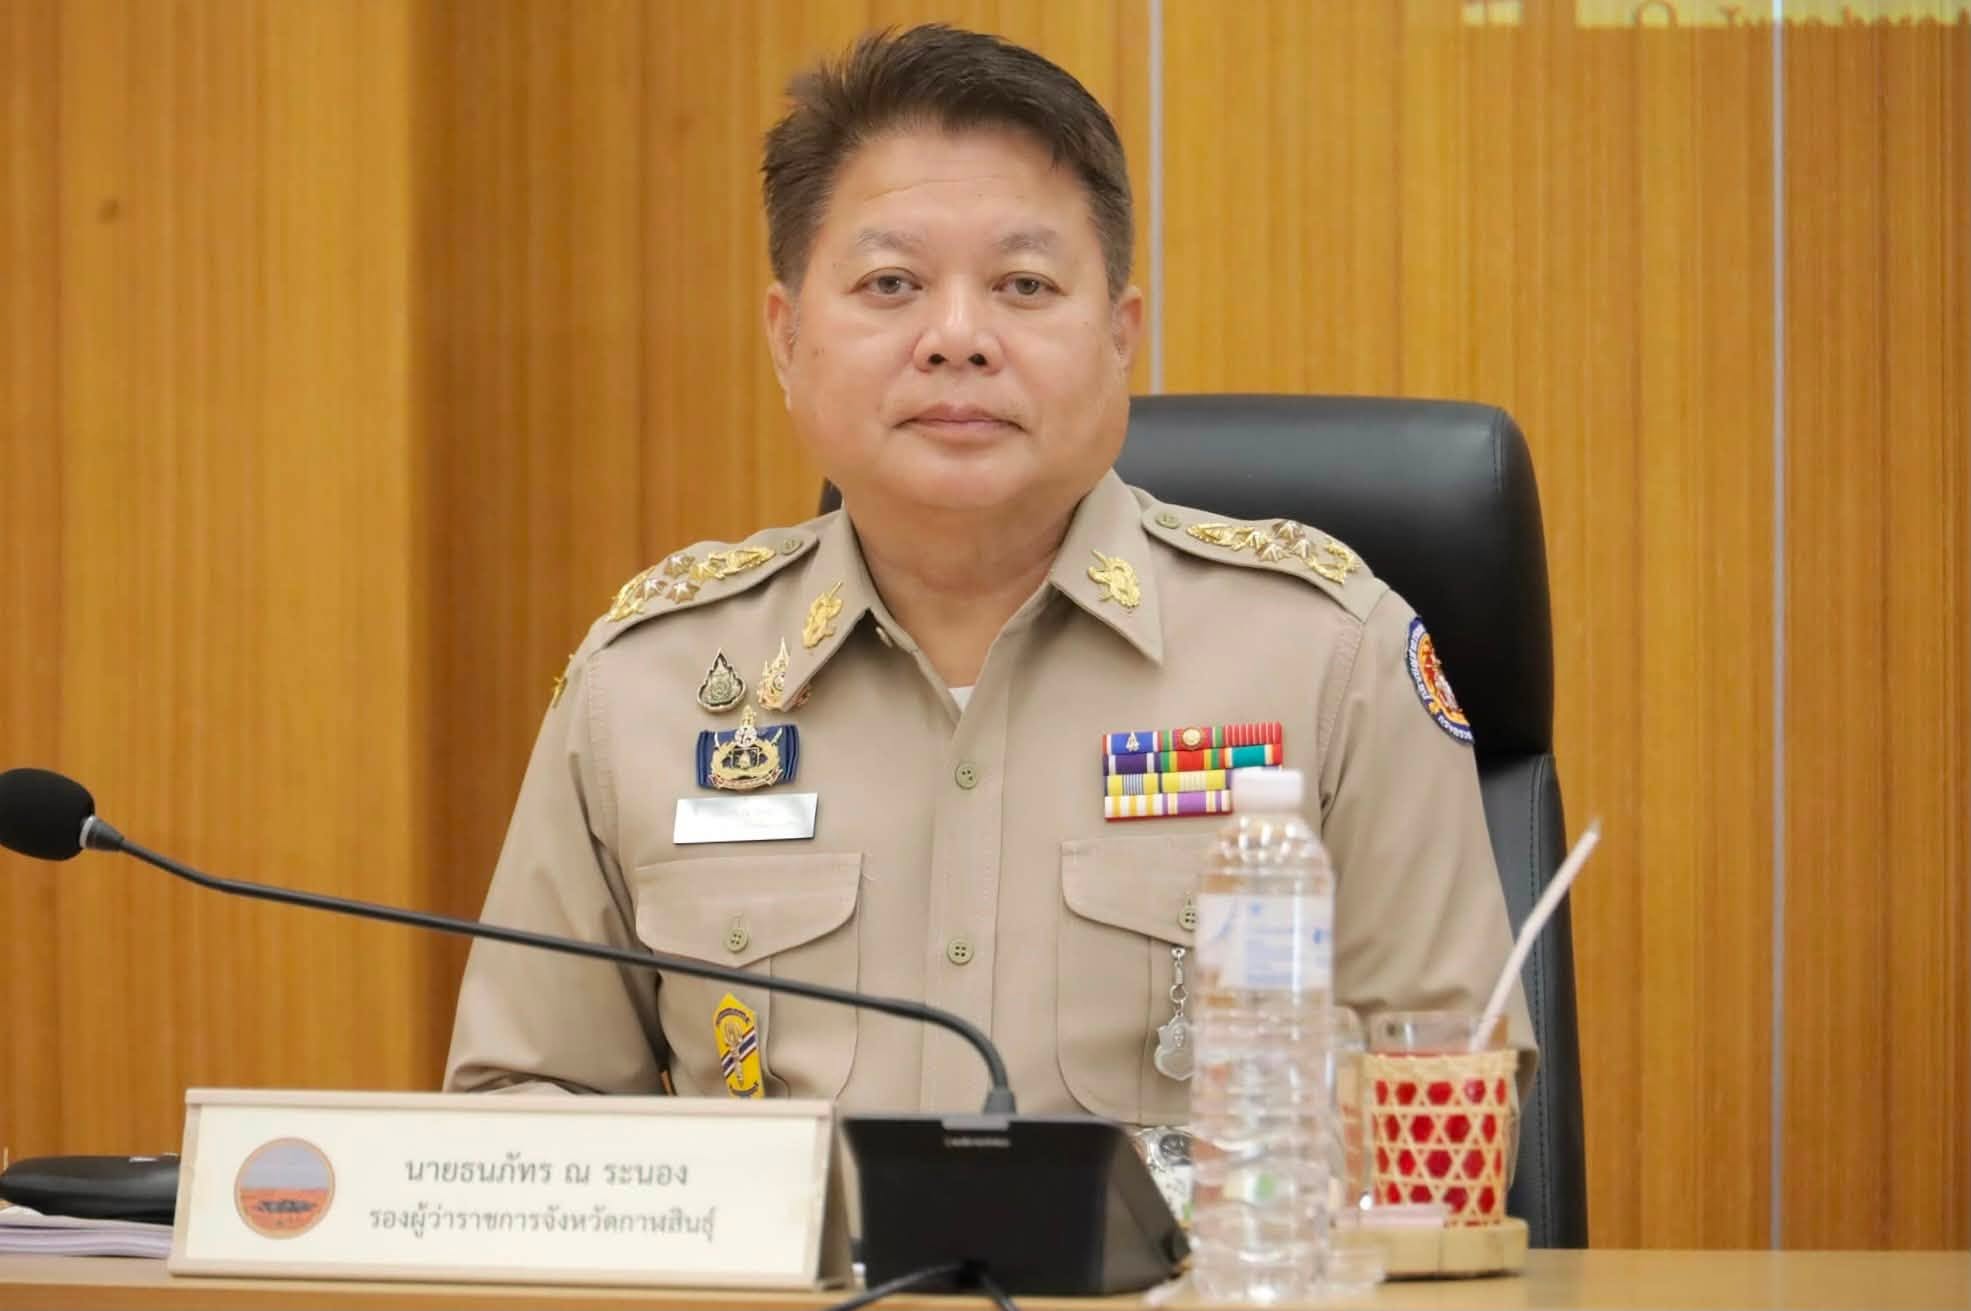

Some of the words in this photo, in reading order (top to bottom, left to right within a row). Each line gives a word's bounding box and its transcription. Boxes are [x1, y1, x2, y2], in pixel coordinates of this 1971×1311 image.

[405, 1151, 552, 1184] นายธนภัทร
[564, 1163, 591, 1184] ณ
[603, 1164, 688, 1186] ระนอง
[369, 1201, 716, 1243] รองผู้ว่าราชการจังหวัดกาฬสินธุ์
